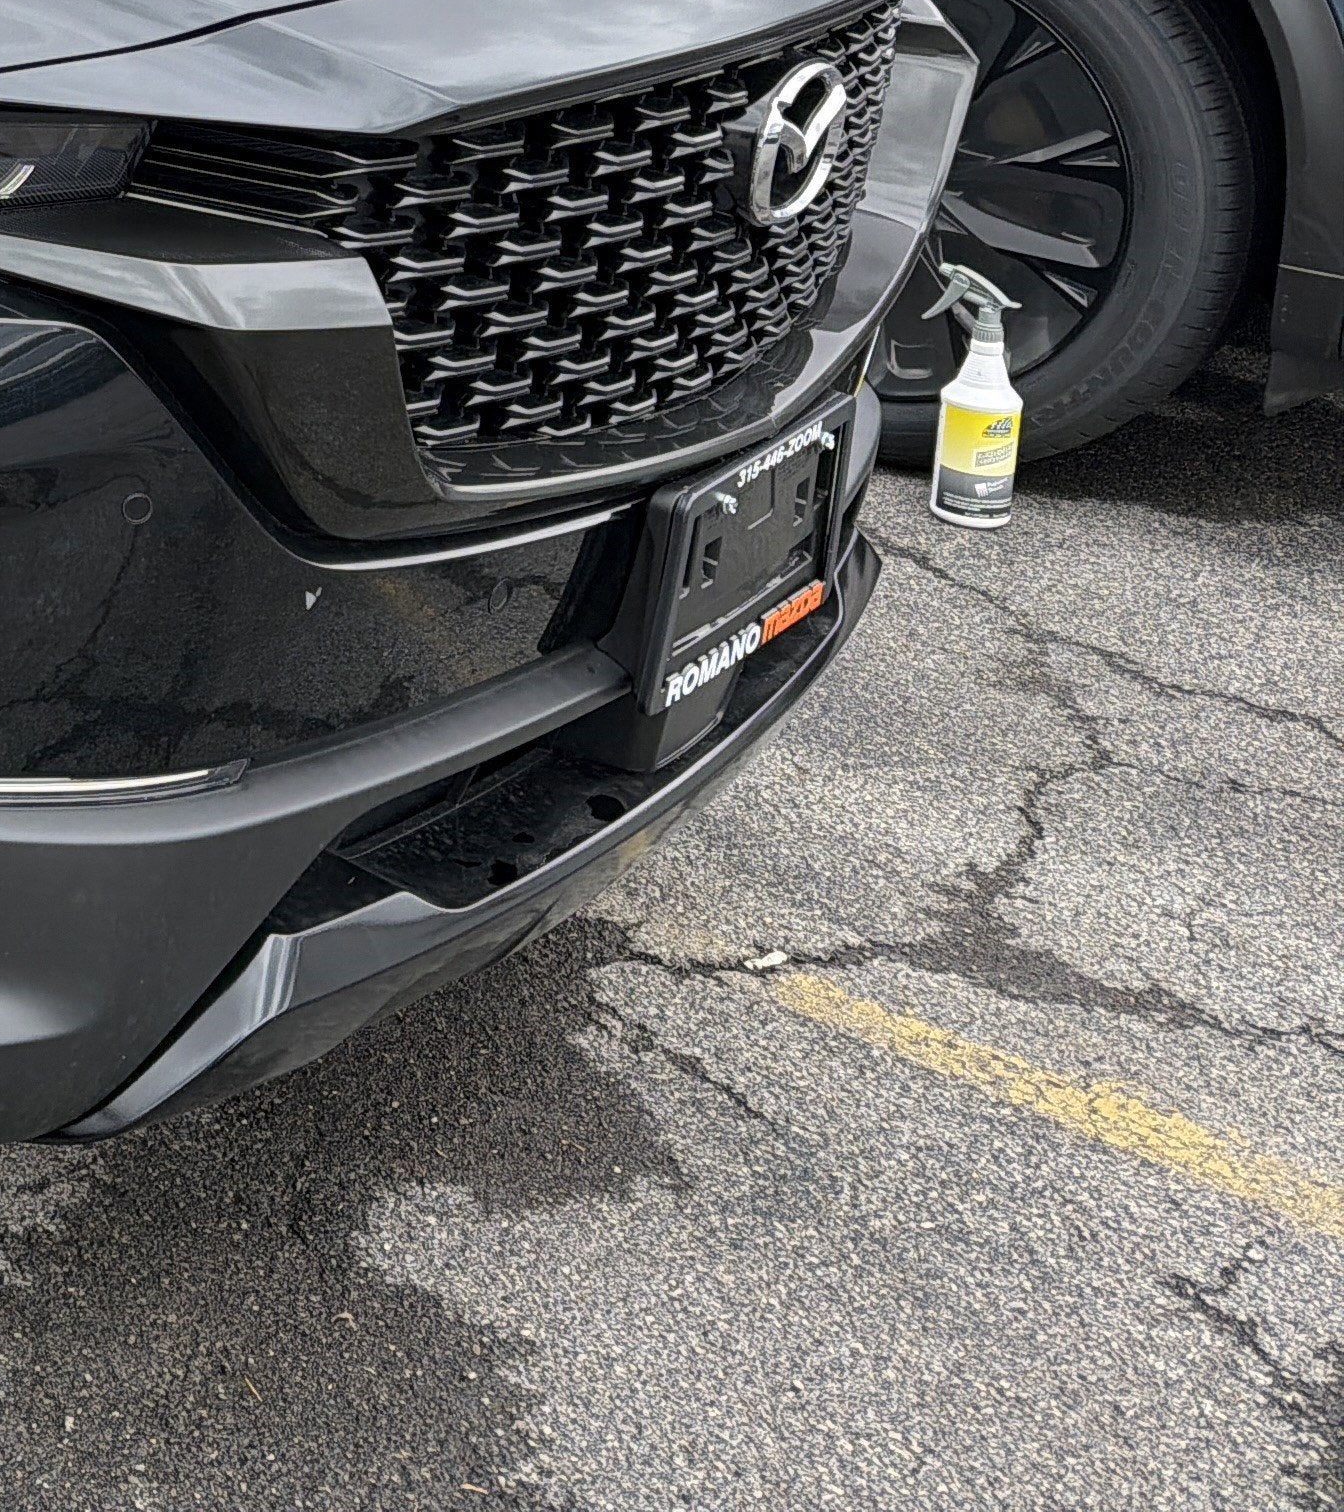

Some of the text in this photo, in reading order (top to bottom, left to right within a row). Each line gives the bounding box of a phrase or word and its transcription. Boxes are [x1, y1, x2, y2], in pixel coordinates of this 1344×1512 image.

[736, 420, 823, 489] 315-446-ZOOM
[664, 580, 827, 708] ROMANO mazda
